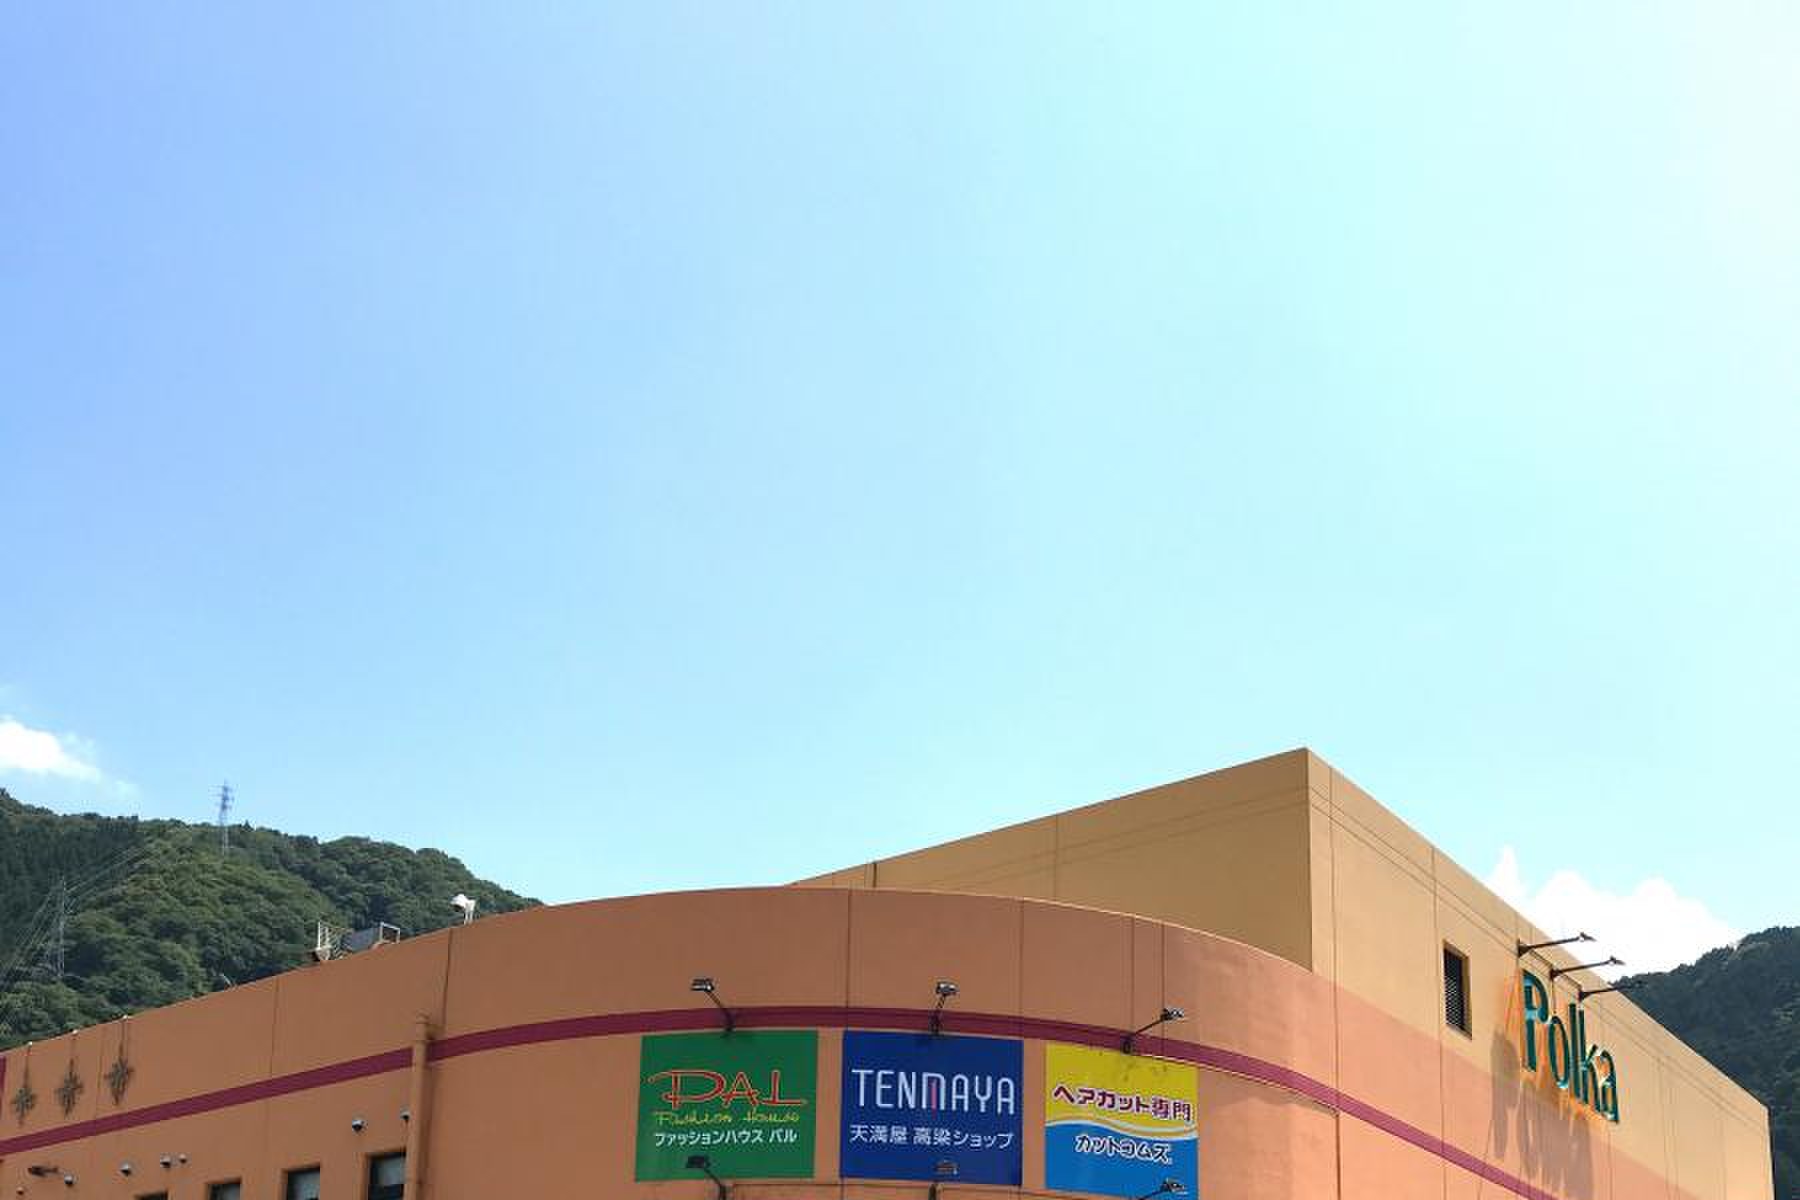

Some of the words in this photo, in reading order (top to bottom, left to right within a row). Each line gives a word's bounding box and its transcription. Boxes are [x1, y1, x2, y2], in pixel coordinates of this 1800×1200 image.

[1523, 969, 1620, 1123] Polka
[648, 1069, 806, 1109] PAL
[851, 1069, 1015, 1116] TENMAYA
[1053, 1084, 1193, 1122] ヘアカット専門
[655, 1129, 764, 1147] ファッションハウス
[850, 1124, 908, 1145] 天満屋
